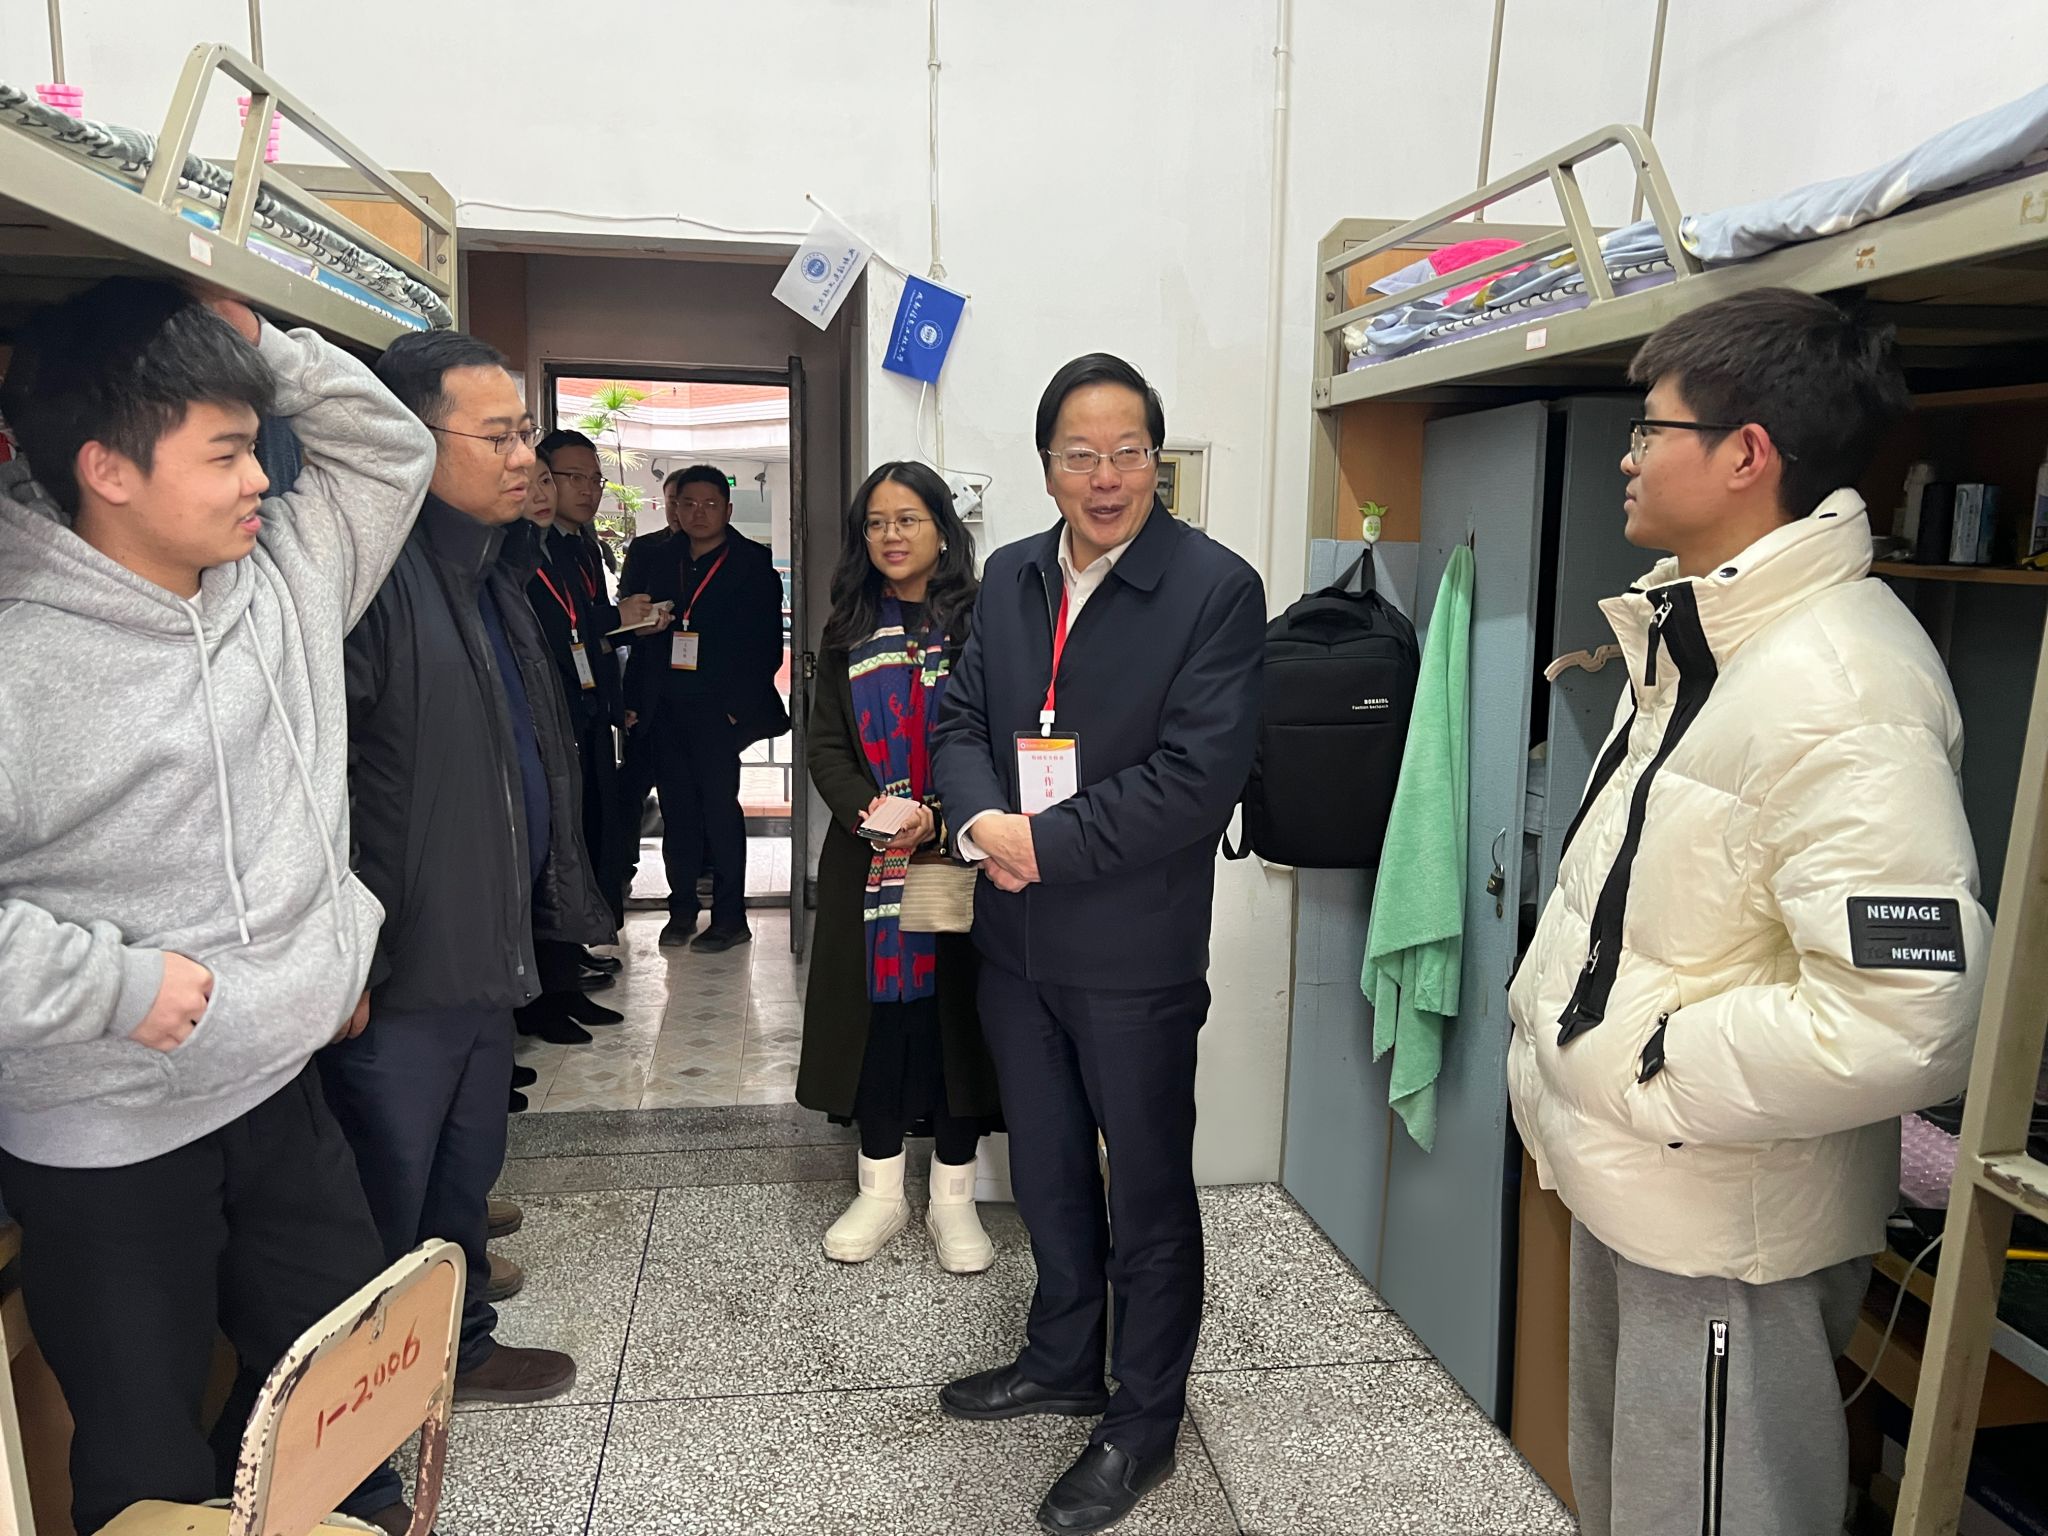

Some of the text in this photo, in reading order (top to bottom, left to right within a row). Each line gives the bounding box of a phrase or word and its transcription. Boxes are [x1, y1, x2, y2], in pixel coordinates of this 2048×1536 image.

[1867, 905, 1941, 921] NEWAGE
[1891, 947, 1956, 962] NEWTIME
[316, 1315, 421, 1448] 1-2006
